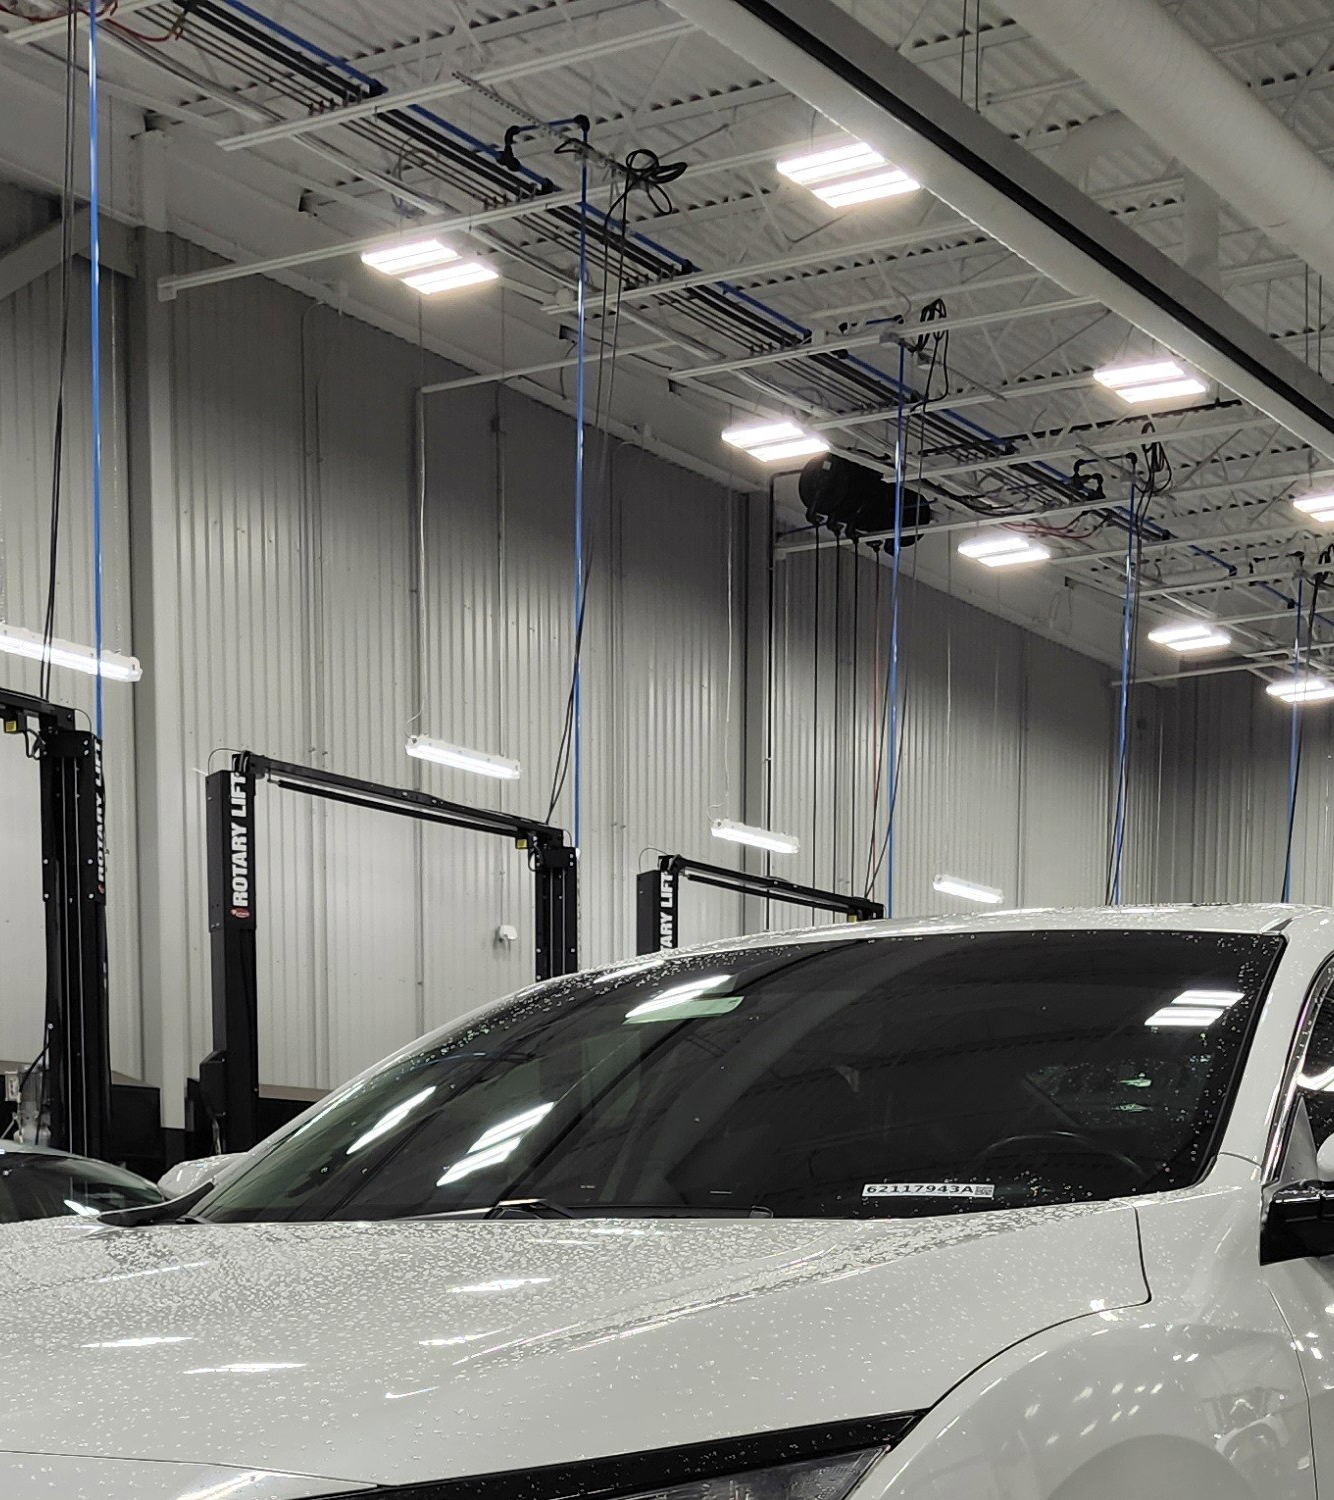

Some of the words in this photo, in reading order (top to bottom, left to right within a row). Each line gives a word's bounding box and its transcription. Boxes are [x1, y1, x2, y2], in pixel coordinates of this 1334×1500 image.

[230, 772, 247, 817] LIFT
[231, 822, 249, 907] ROTARY
[660, 871, 673, 907] LIFT
[660, 911, 673, 949] ARY
[866, 1185, 974, 1194] 62117943A
